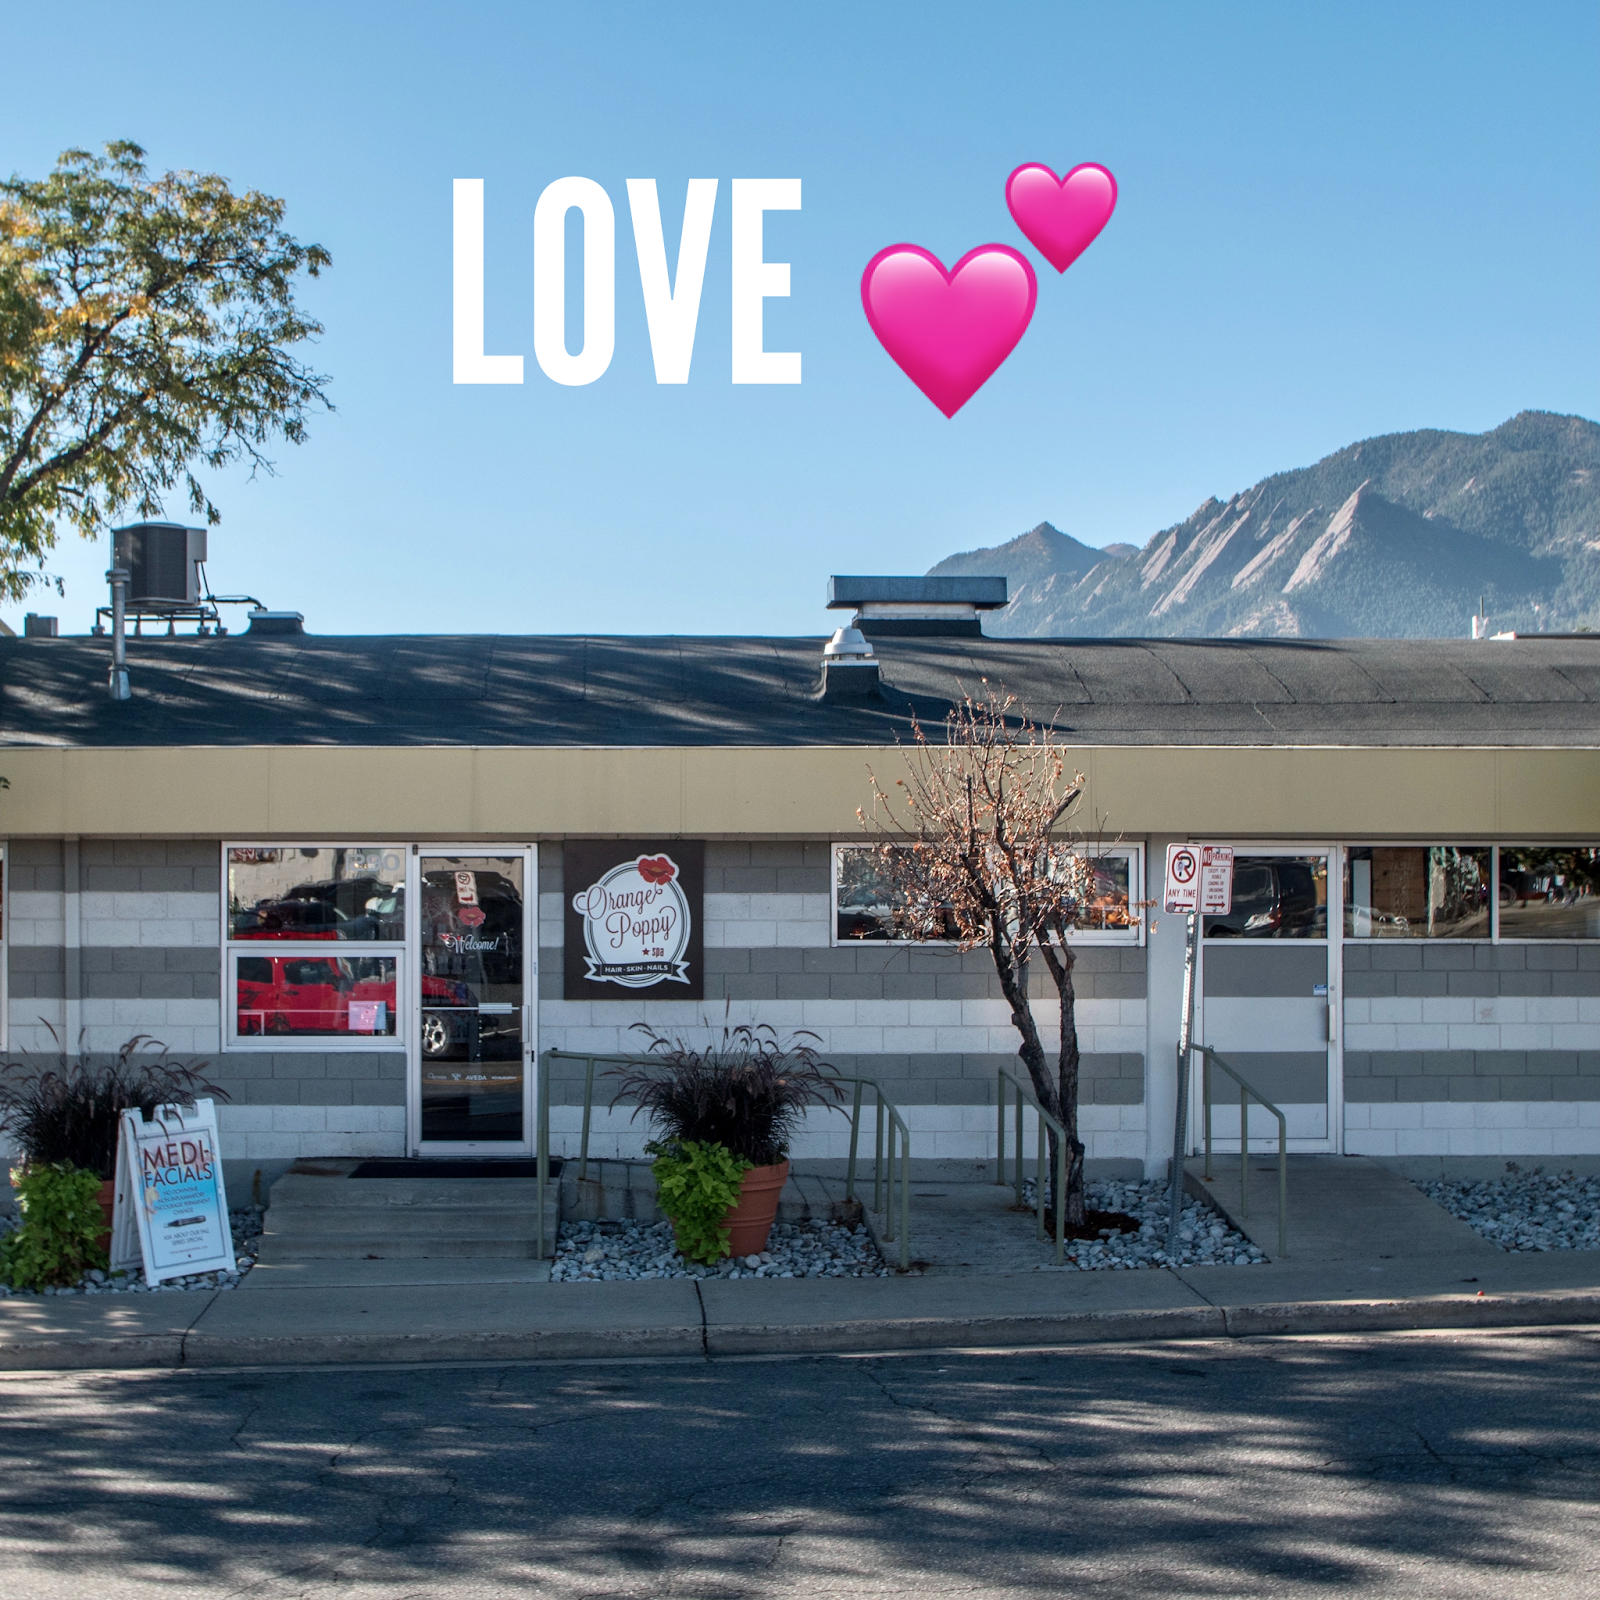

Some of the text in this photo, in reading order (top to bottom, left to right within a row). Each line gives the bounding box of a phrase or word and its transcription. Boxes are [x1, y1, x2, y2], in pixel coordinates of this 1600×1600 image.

[345, 853, 400, 872] 1290
[1203, 850, 1231, 864] NO PARKING
[1168, 889, 1196, 898] ANY TIME
[576, 886, 662, 920] Orange
[606, 906, 677, 948] Poppy
[445, 934, 500, 954] Welcome!
[651, 946, 665, 958] spa
[604, 964, 669, 973] HAIR SKIN NAILS
[144, 1139, 209, 1171] MEDI-
[144, 1162, 213, 1189] FACIALS
[172, 1186, 198, 1195] DOWNTIME
[173, 1207, 194, 1215] CHANGE
[174, 1231, 189, 1239] ABOUT
[189, 1229, 200, 1237] OUR
